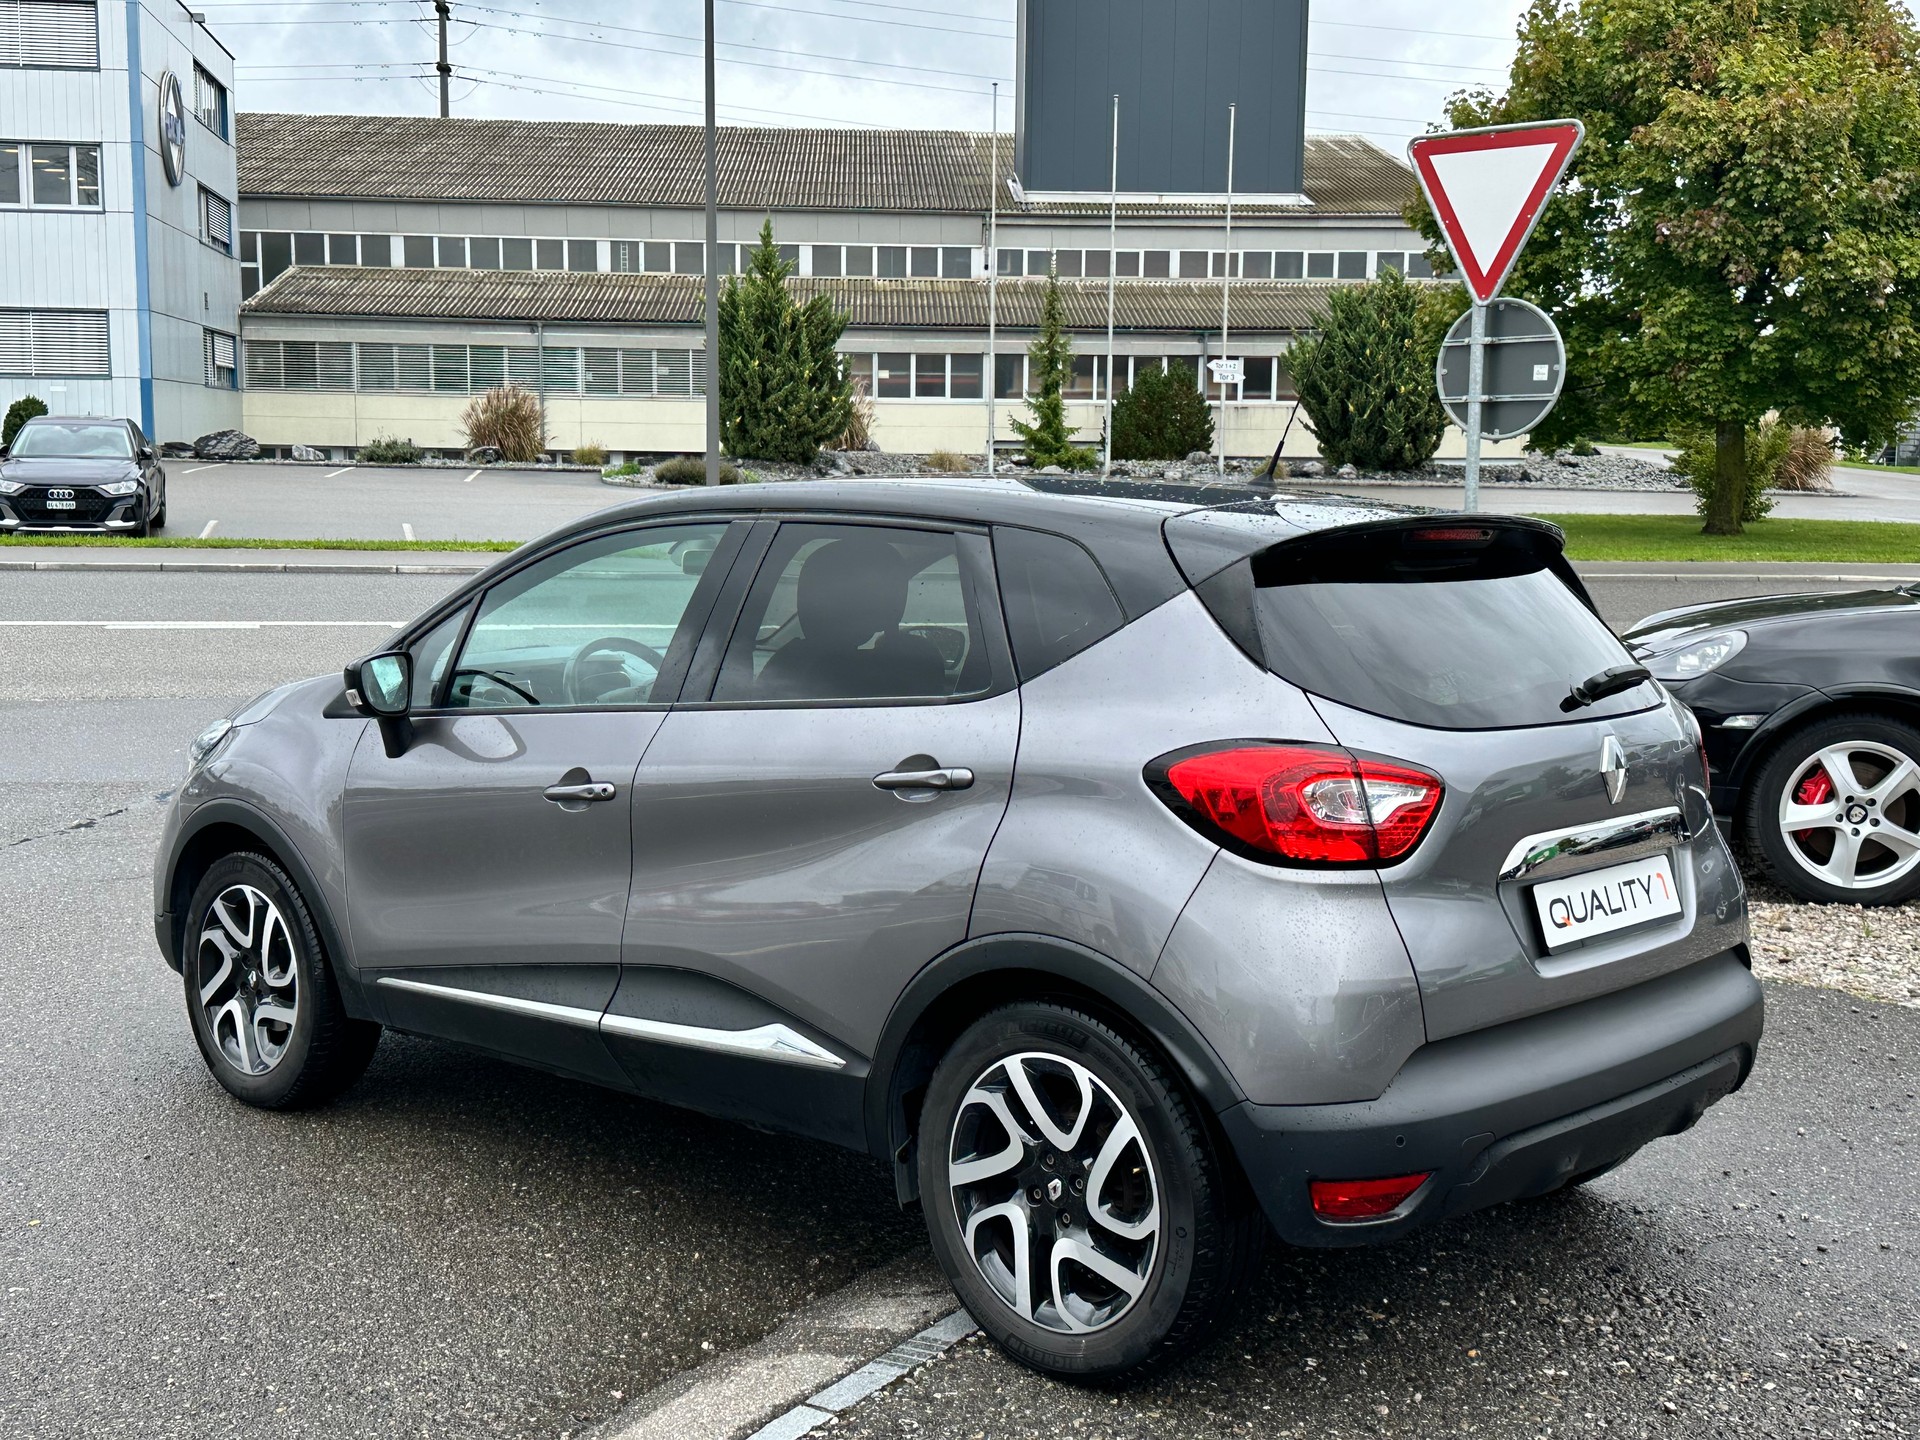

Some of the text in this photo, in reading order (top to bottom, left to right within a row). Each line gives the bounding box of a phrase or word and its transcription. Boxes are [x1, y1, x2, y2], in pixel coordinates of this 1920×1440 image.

[1218, 373, 1230, 381] Tor
[1549, 872, 1669, 929] QUALITY 1
[1006, 1336, 1085, 1371] MICHELIN
